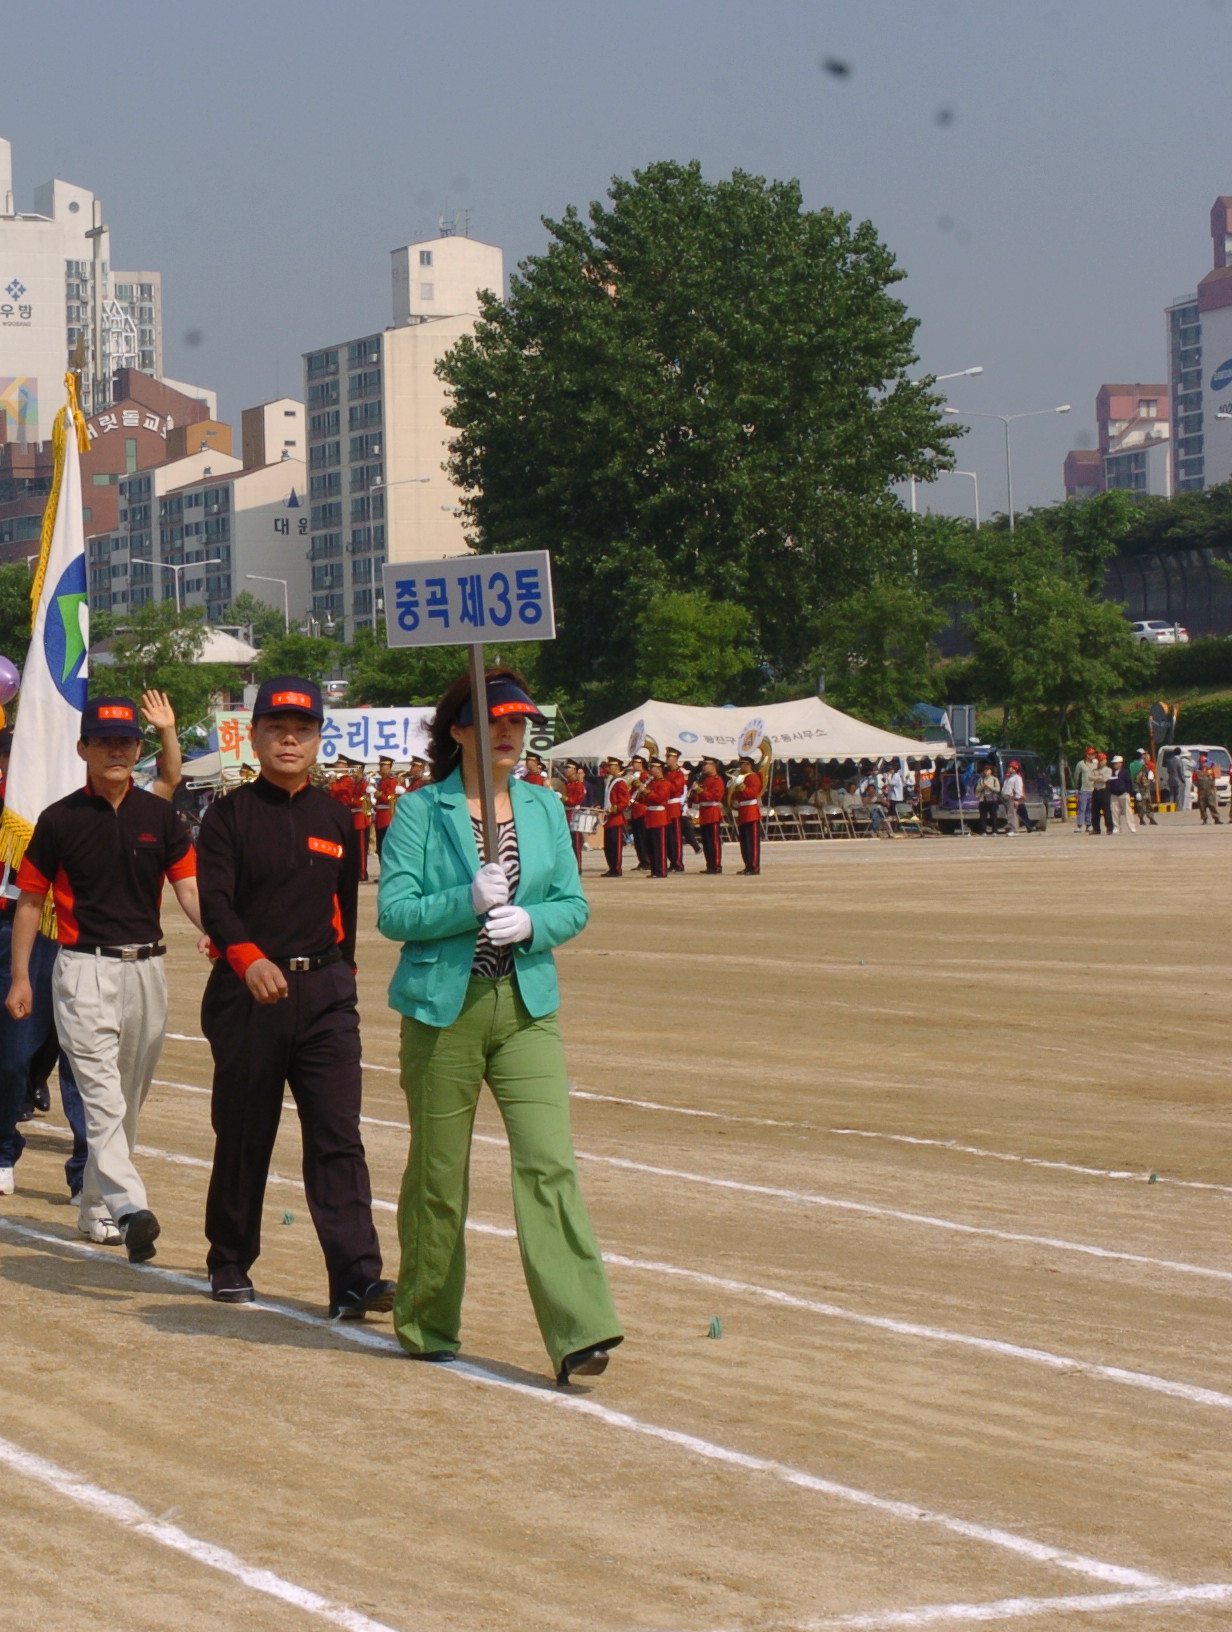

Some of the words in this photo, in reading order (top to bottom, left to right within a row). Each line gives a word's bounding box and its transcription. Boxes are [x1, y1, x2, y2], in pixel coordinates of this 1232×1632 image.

[0, 303, 32, 320] 우방
[87, 409, 167, 440] 릿돌교
[395, 568, 543, 632] 중곡제3동
[321, 715, 410, 758] 승리도!
